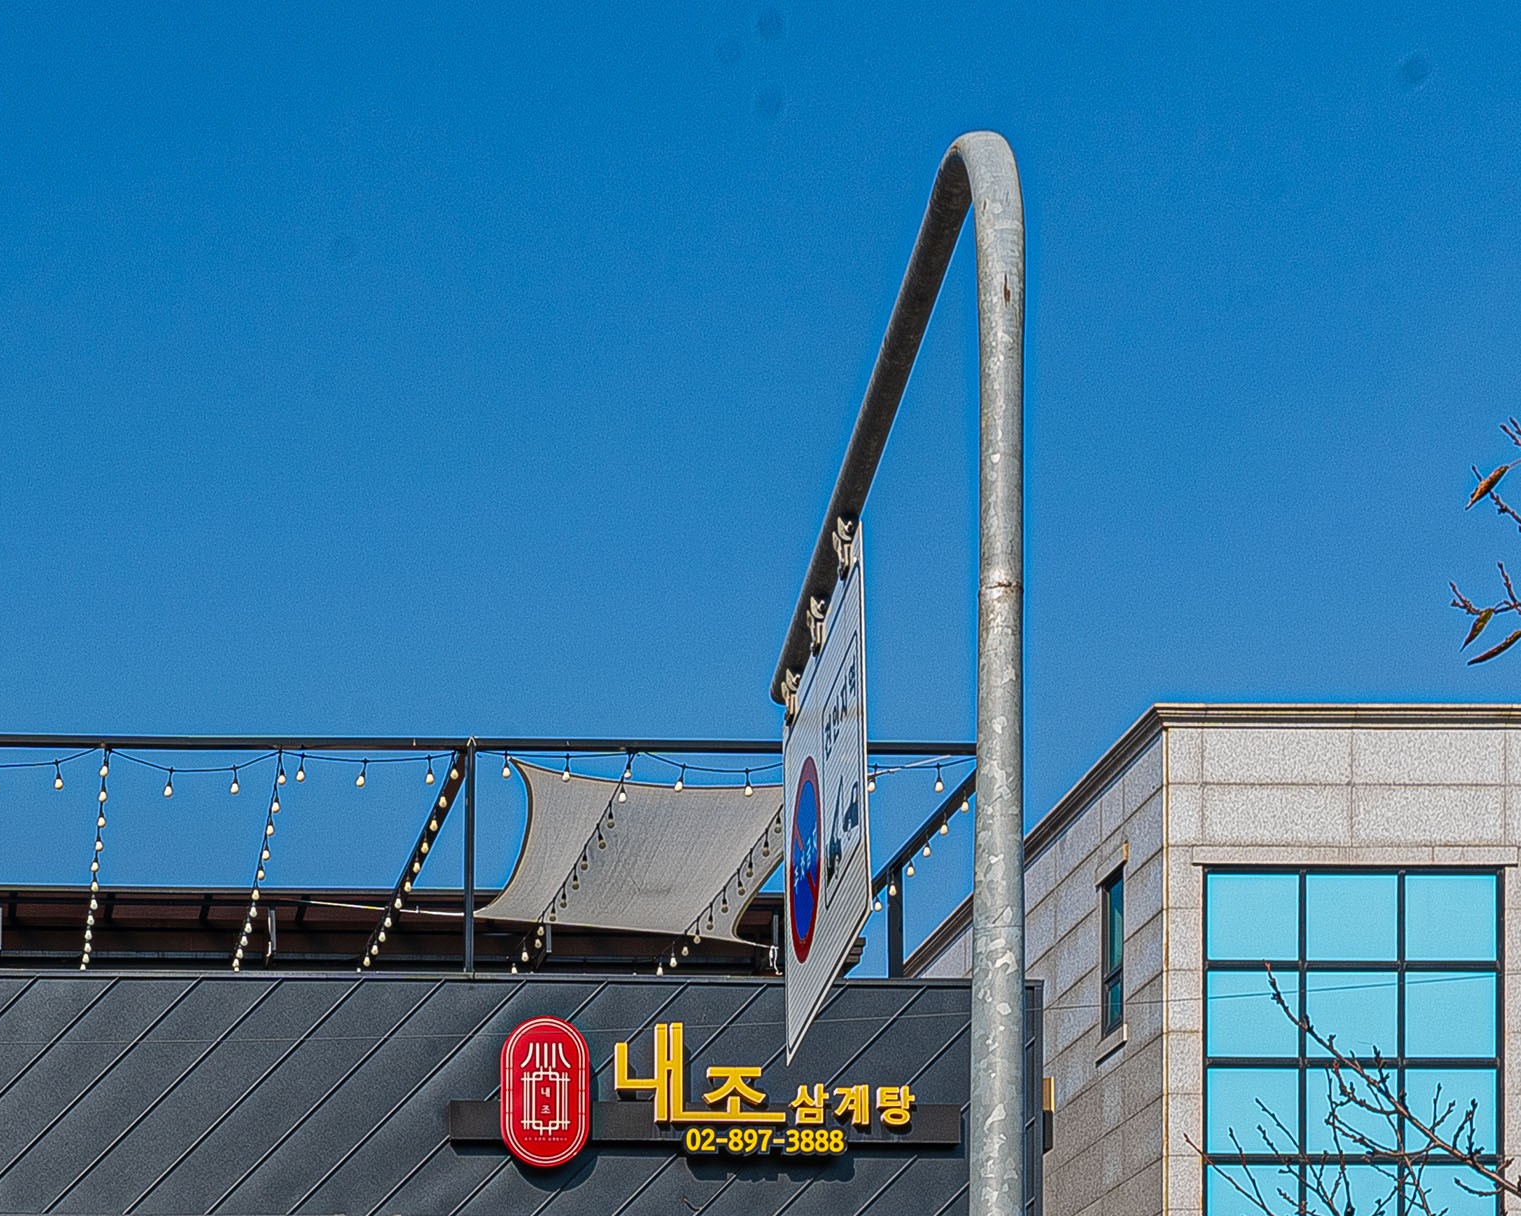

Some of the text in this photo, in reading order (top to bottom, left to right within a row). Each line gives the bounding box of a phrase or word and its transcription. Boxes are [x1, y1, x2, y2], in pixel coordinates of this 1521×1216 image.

[825, 655, 856, 762] 견인지역
[614, 1022, 915, 1127] 내조 삼계탕
[685, 1127, 844, 1153] 02-897-3888
